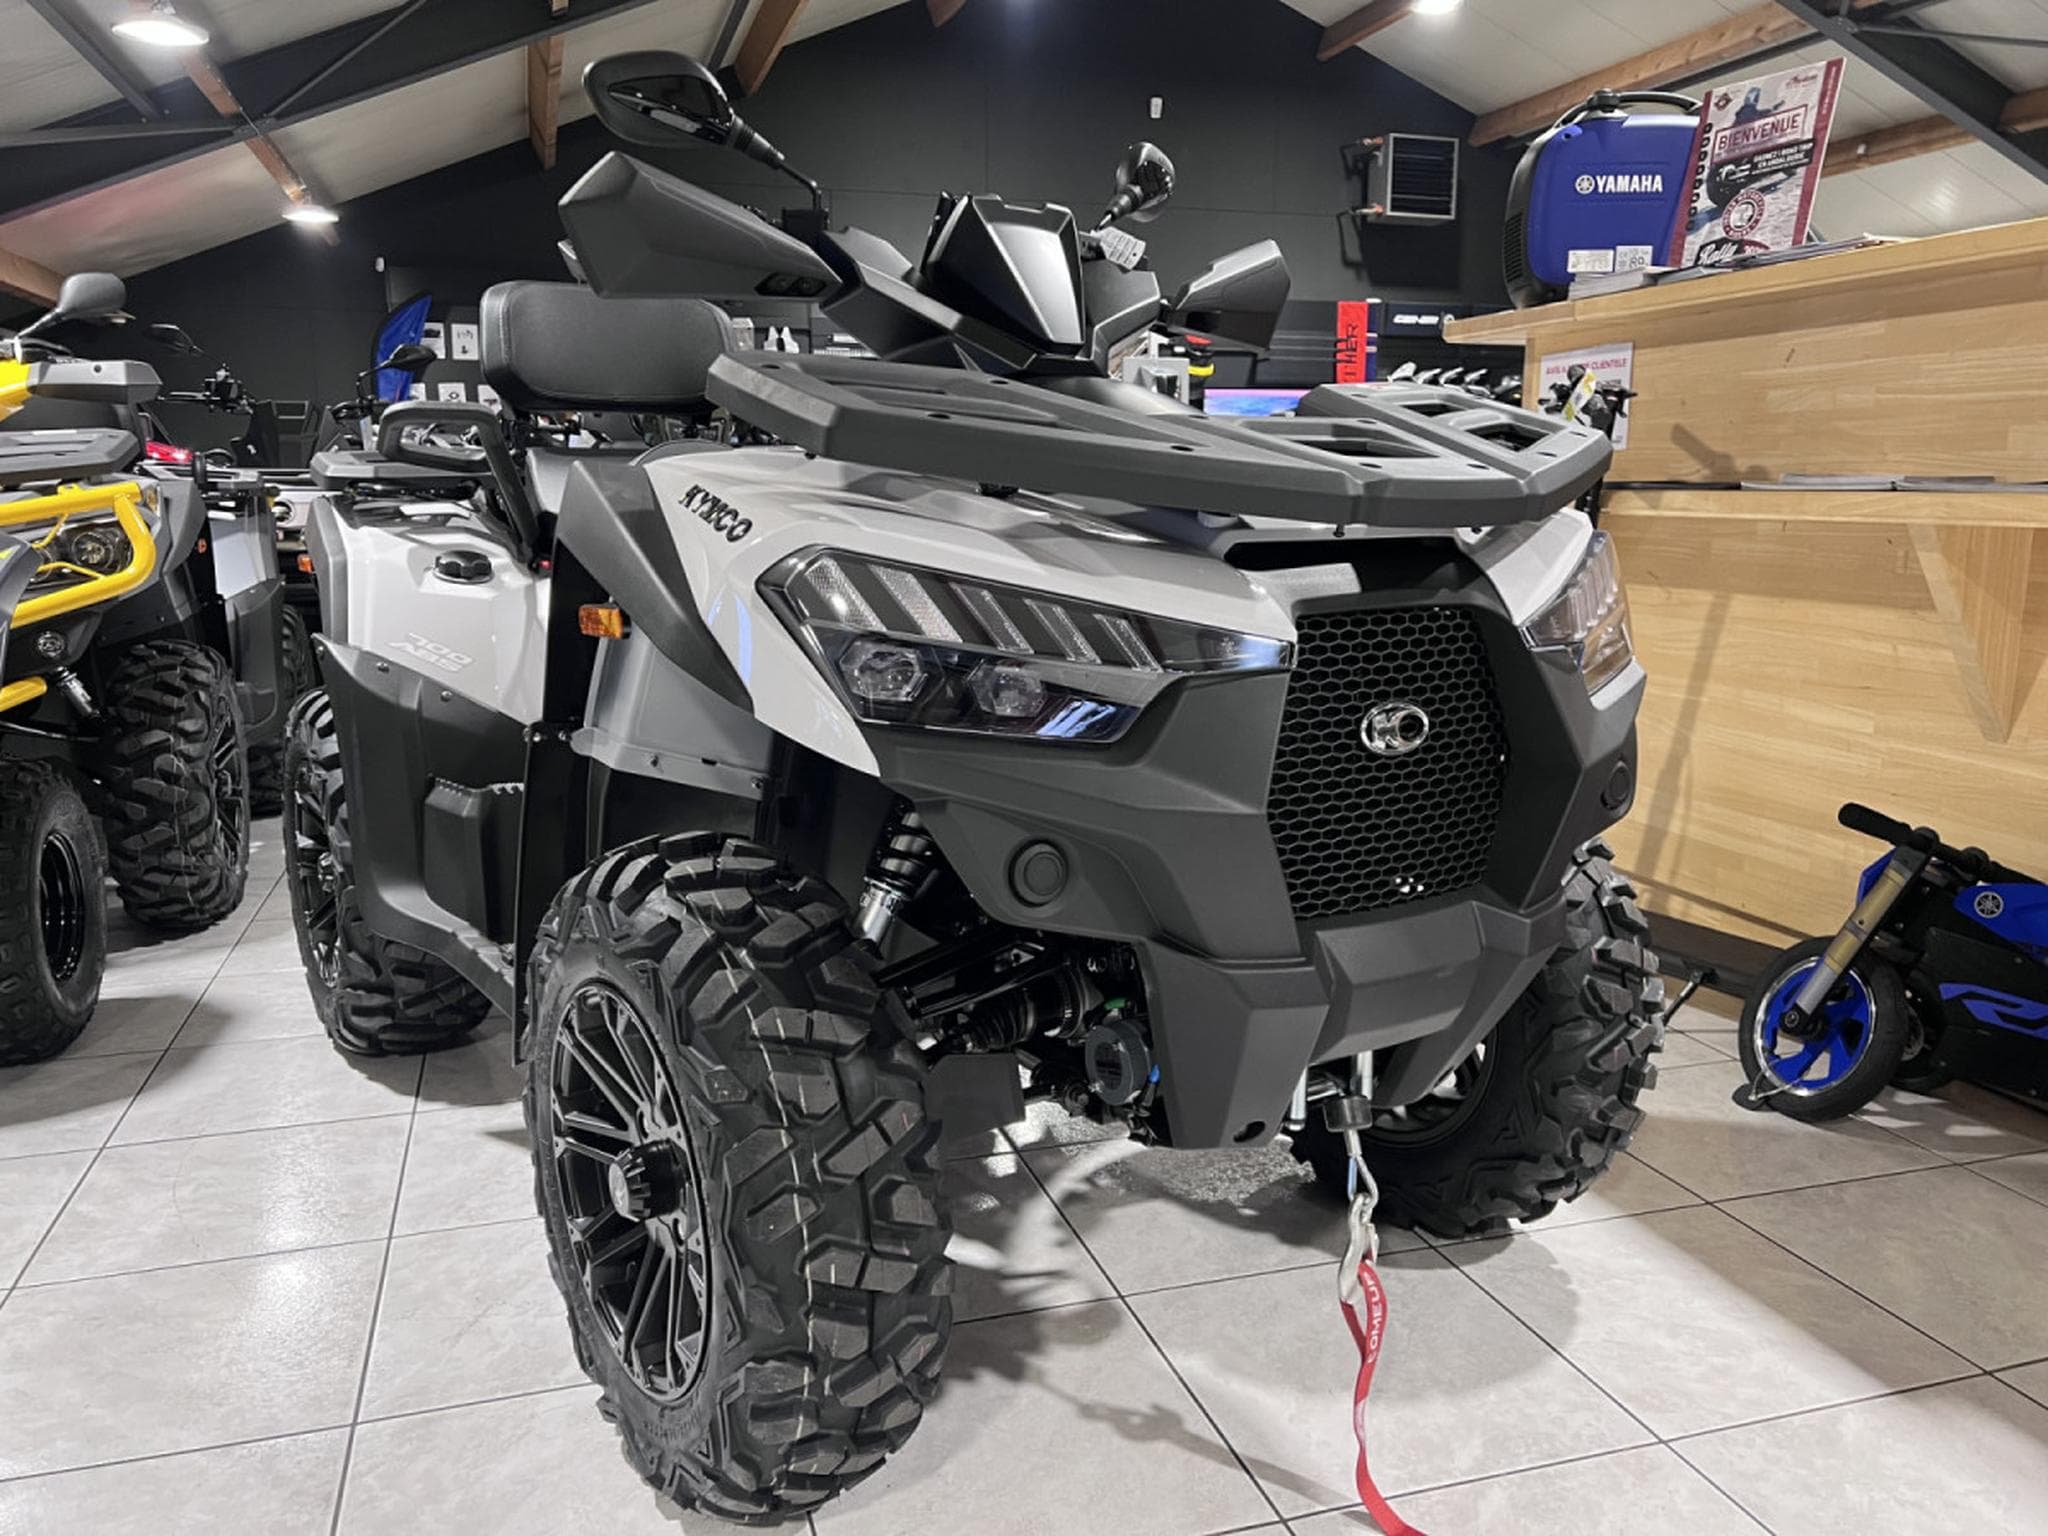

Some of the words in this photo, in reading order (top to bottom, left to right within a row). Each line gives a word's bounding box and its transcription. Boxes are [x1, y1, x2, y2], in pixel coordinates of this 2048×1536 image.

[1718, 113, 1801, 150] BIENVENUE
[1596, 174, 1663, 193] YAMAHA
[678, 484, 753, 543] KYMCO
